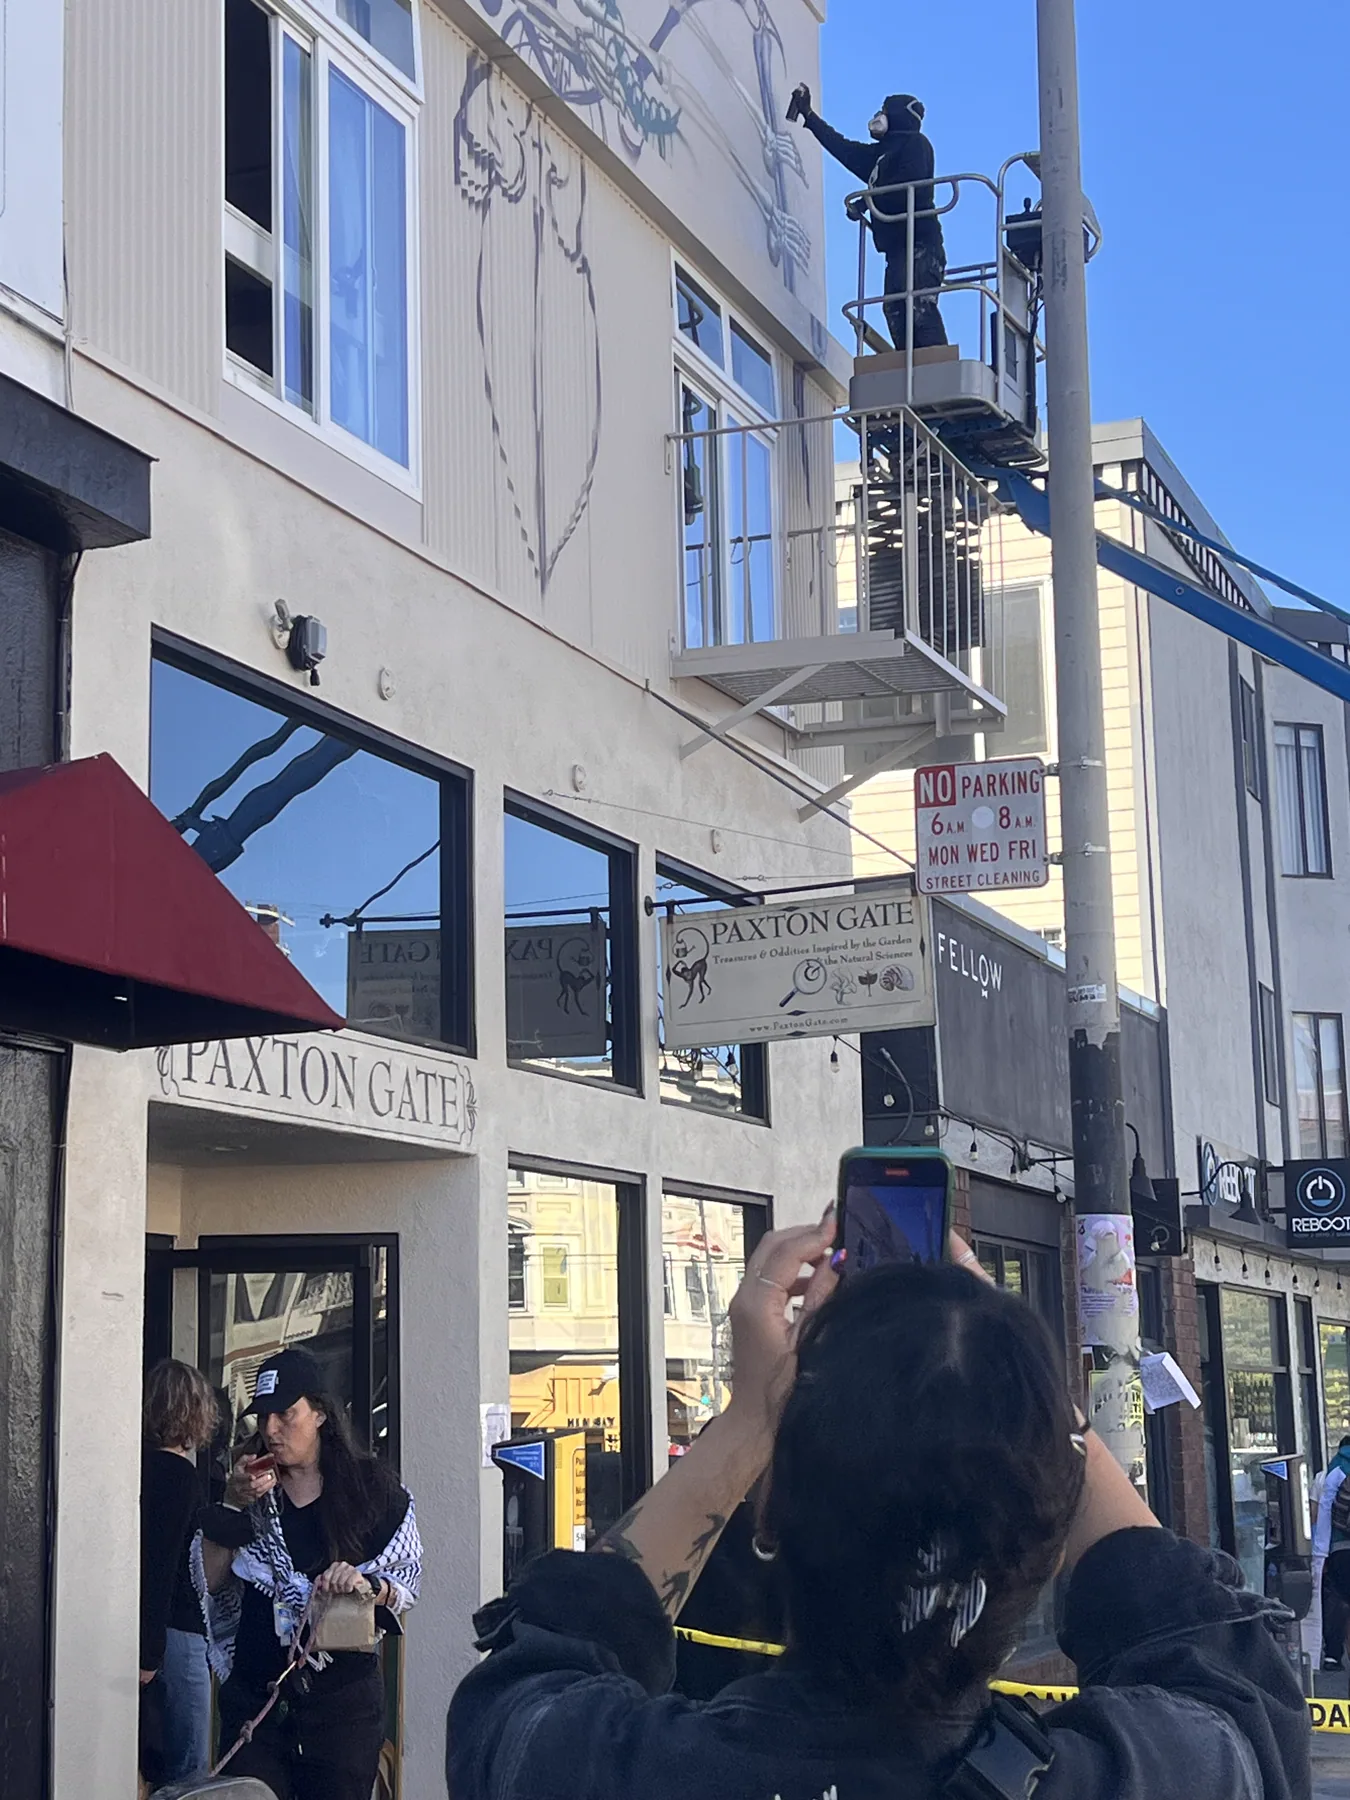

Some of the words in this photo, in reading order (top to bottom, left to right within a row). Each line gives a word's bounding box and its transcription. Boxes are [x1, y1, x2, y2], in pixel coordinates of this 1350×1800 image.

[919, 770, 952, 804] NO
[962, 769, 1040, 799] PARKING
[931, 812, 944, 835] 6
[999, 806, 1011, 829] 8
[928, 845, 959, 866] MON
[966, 842, 999, 863] WED
[1008, 839, 1037, 860] FRI
[926, 874, 972, 890] STREET
[977, 870, 1040, 886] CLEANING
[711, 909, 830, 945] PAXTON
[836, 901, 914, 931] GATE
[712, 953, 757, 965] Treasures
[769, 947, 810, 959] Oddities
[812, 942, 849, 956] Inspired
[850, 940, 861, 951] by
[862, 938, 876, 948] the
[878, 935, 912, 947] Garden
[824, 955, 838, 966] the
[839, 951, 873, 964] Natural
[875, 949, 913, 961] Sciences
[938, 932, 1002, 992] FELLOW
[749, 1017, 849, 1032] www.PaxtonGate.com
[181, 1036, 358, 1111] PAXTON
[368, 1059, 460, 1130] GATE
[1292, 1216, 1350, 1232] REBOOT
[1309, 1703, 1350, 1727] DA
